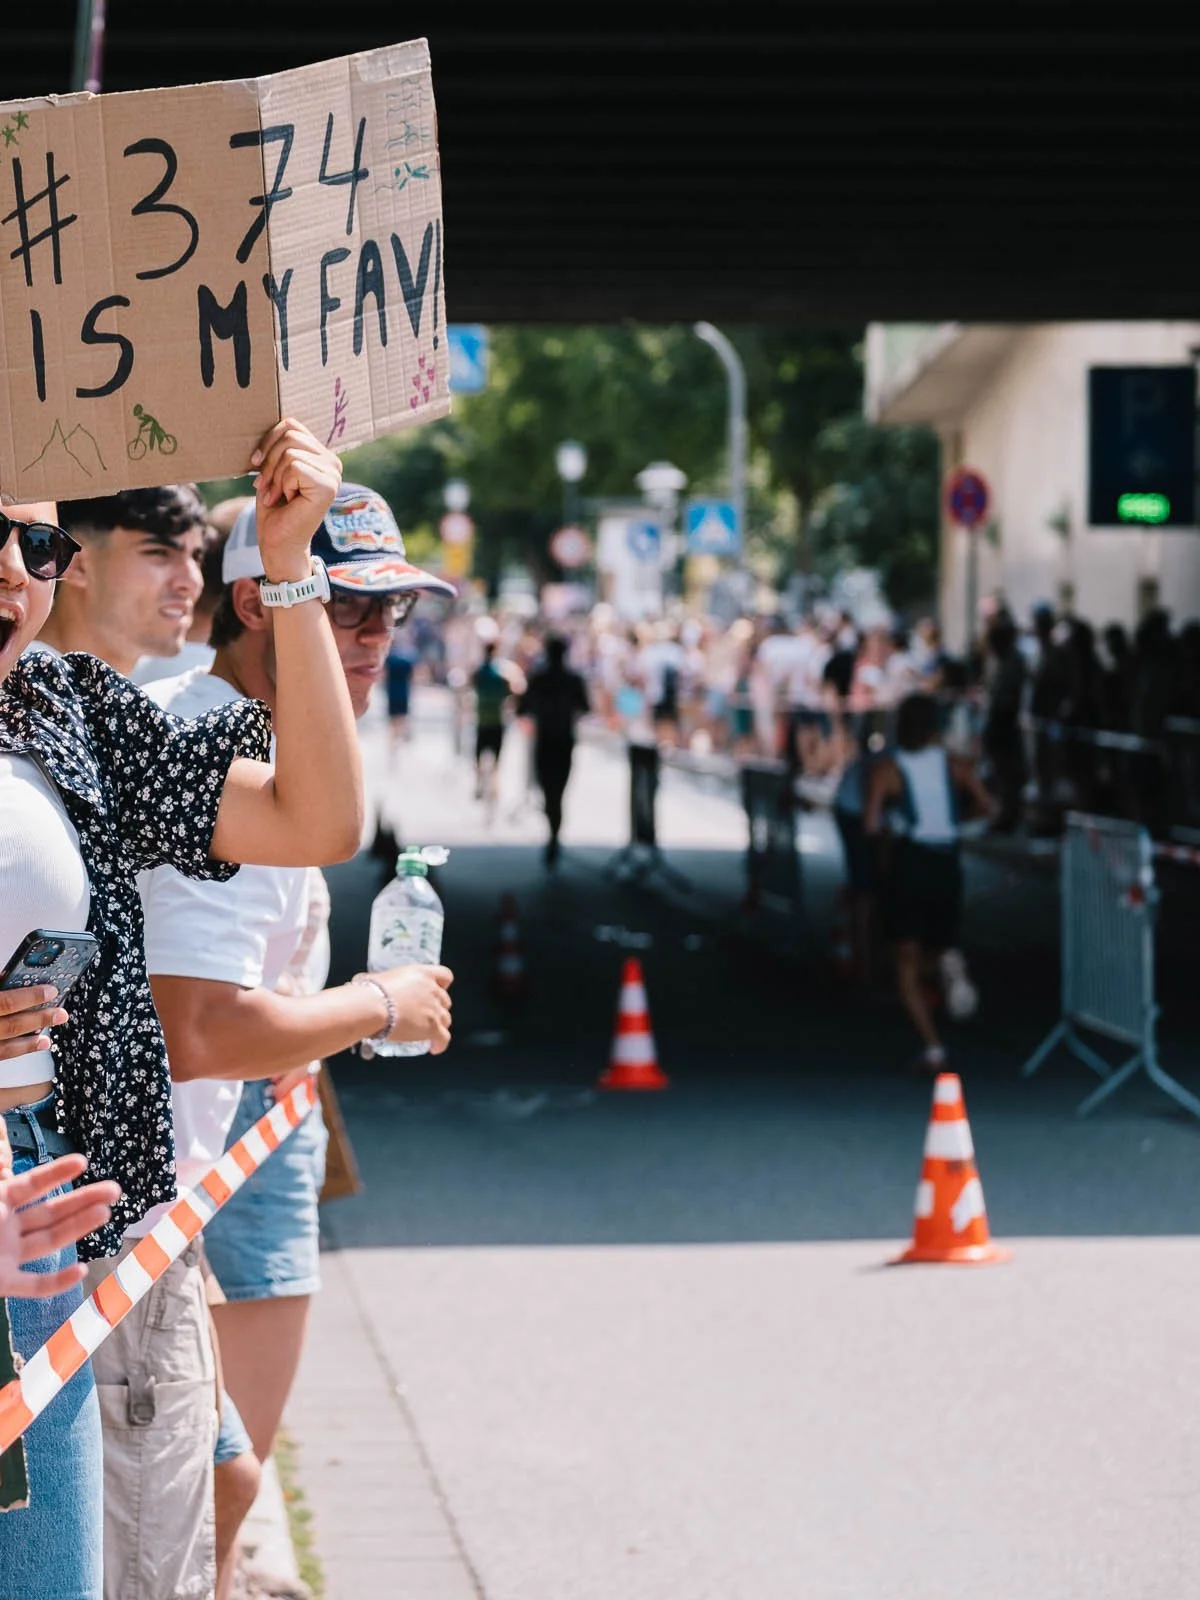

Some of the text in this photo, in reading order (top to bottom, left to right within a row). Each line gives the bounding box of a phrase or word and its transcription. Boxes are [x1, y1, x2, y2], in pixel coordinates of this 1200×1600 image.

[30, 218, 441, 402] IS MY FAV!
